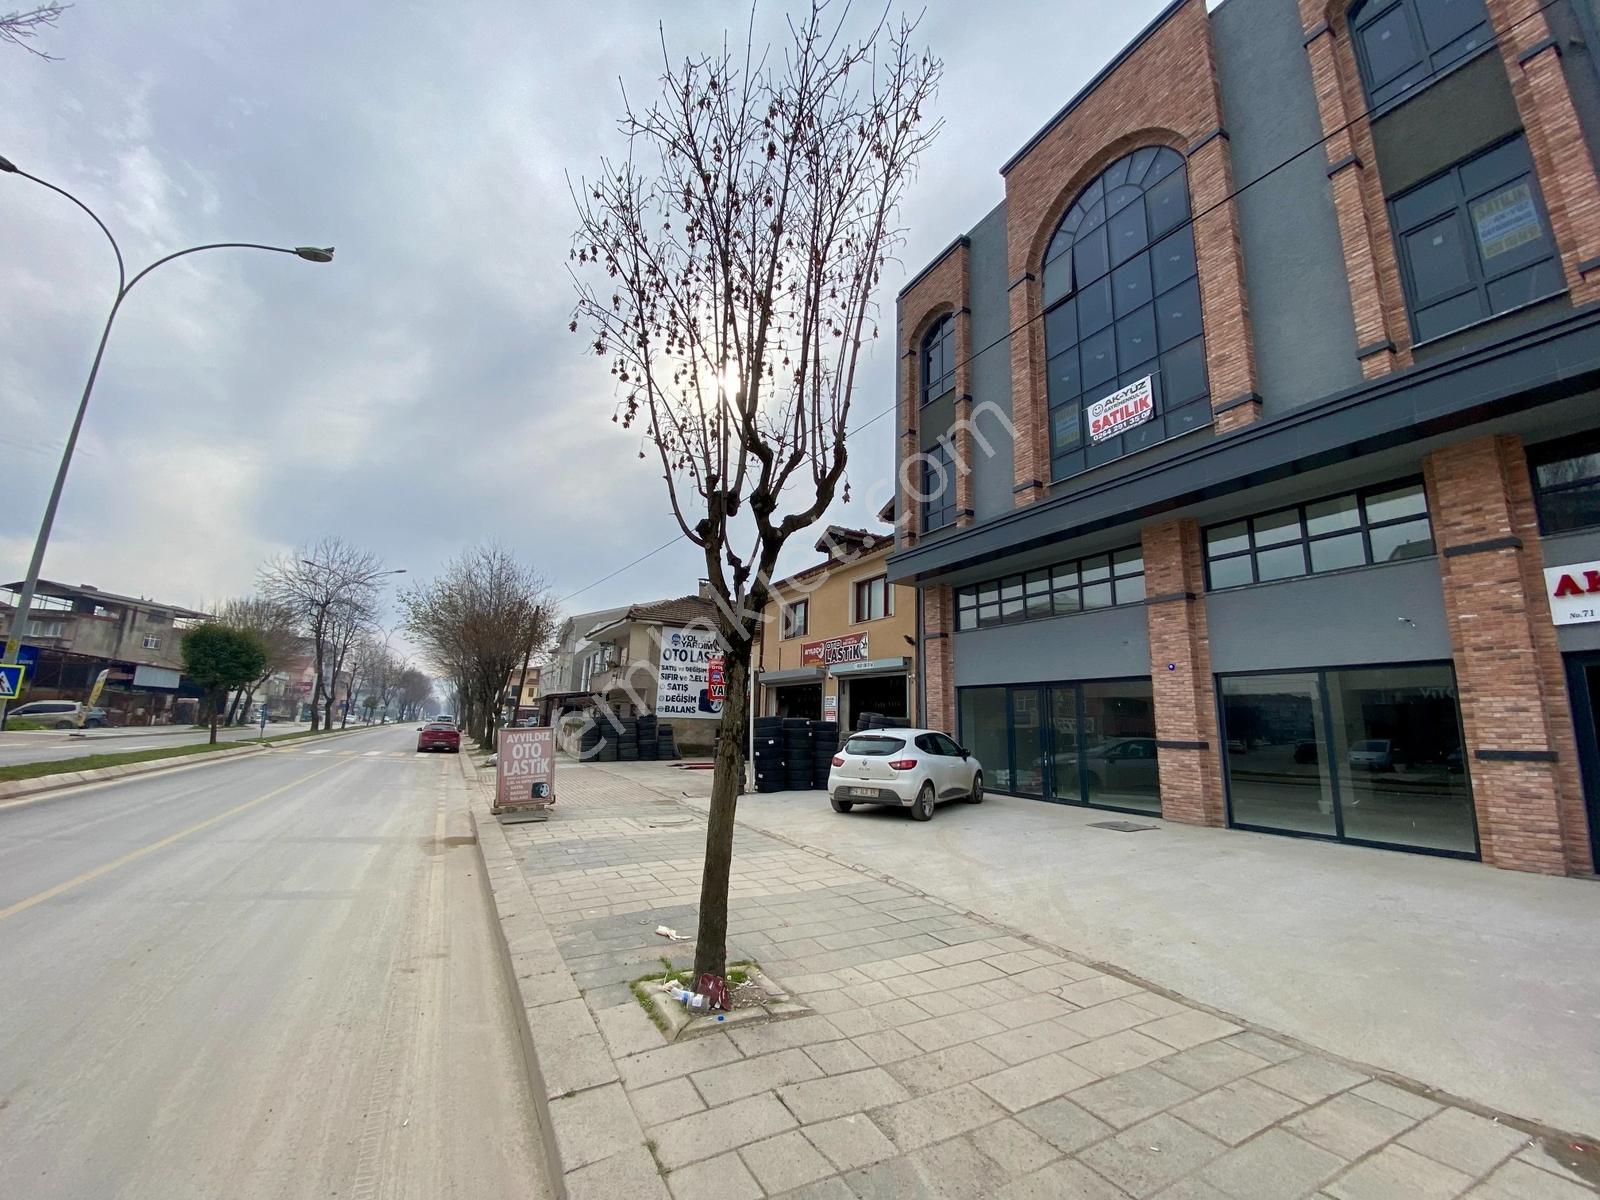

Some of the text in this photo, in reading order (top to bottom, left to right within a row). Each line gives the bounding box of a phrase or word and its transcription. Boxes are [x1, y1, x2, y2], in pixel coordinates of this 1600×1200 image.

[1103, 380, 1147, 407] AK-YÜZ
[1091, 394, 1151, 434] SATILIK
[1093, 428, 1112, 441] 0264
[1129, 416, 1140, 425] 35
[825, 639, 841, 650] OTO
[663, 648, 688, 662] OTO
[825, 643, 861, 664] LASTİK
[661, 672, 679, 680] SIFIR
[667, 683, 688, 692] SATIŞ
[711, 685, 725, 697] YA
[665, 694, 697, 704] DEĞİŞİM
[664, 705, 696, 714] BALANS
[506, 731, 551, 744] AYYILDIZ
[512, 743, 542, 760] OTO
[503, 758, 550, 777] LASTİK
